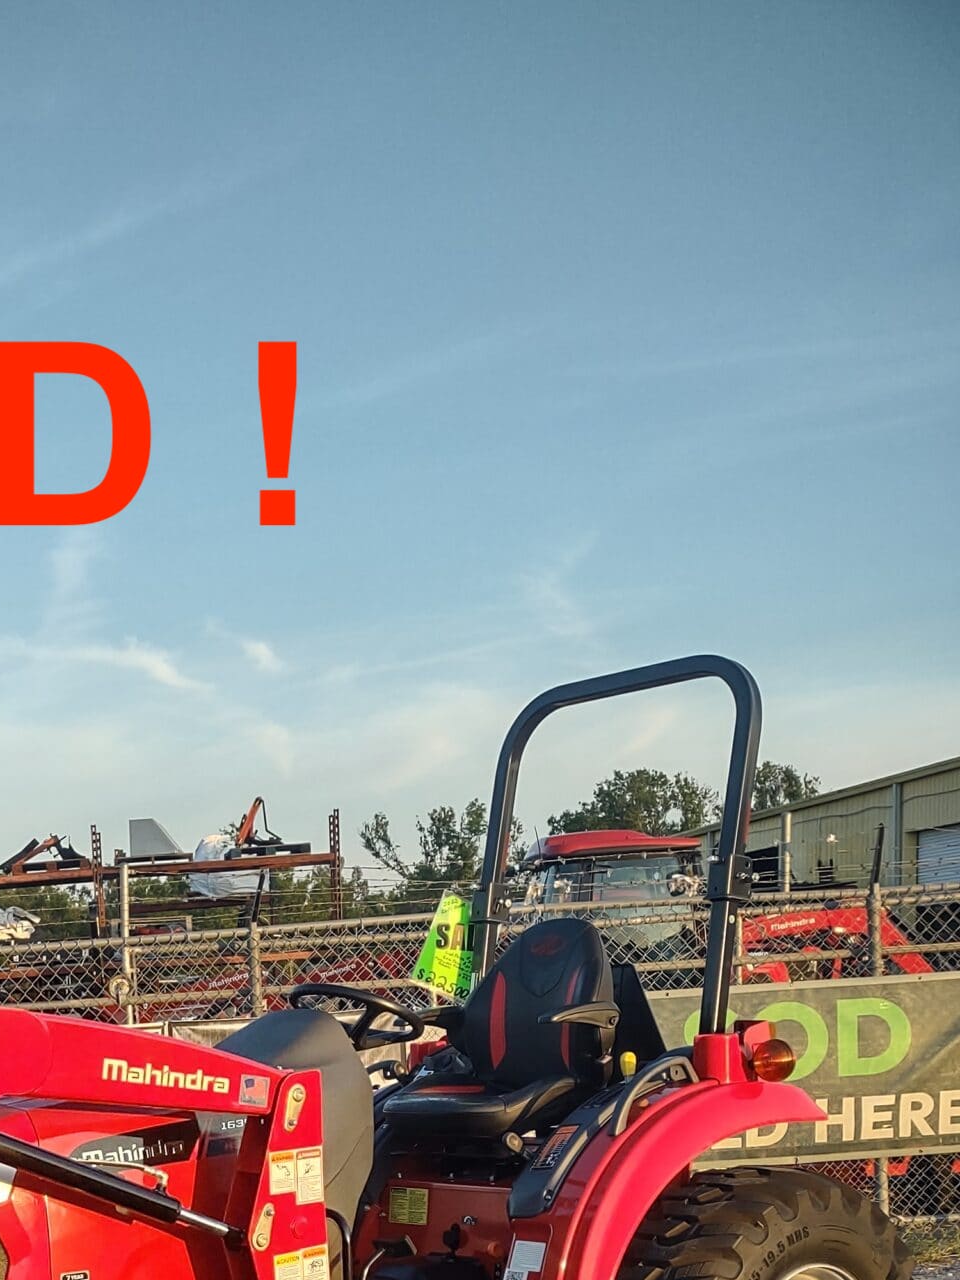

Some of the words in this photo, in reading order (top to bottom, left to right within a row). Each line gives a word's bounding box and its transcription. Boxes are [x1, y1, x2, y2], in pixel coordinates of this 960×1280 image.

[102, 1058, 230, 1093] Mahindra
[221, 1118, 247, 1130] 163
[815, 1090, 960, 1142] HERE
